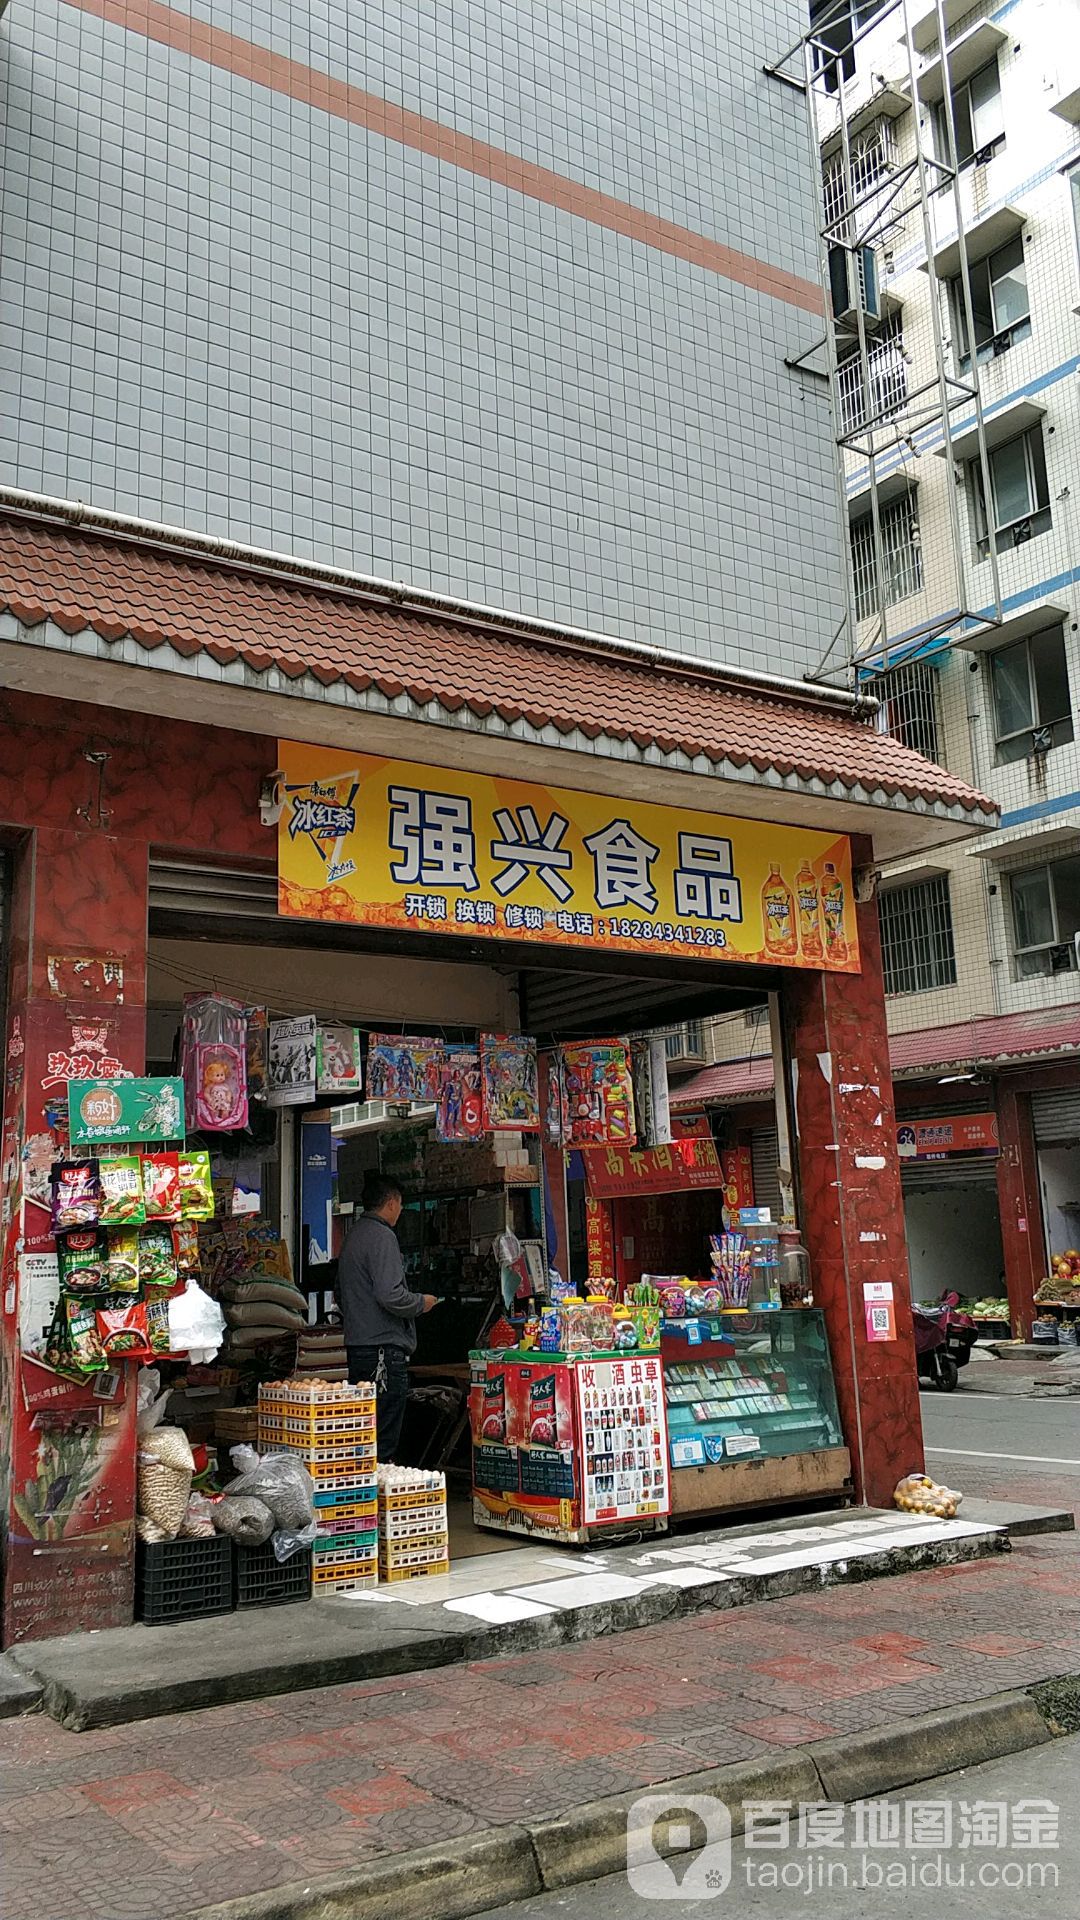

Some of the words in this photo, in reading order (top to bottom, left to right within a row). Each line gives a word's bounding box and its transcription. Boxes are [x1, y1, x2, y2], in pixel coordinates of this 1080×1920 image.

[288, 796, 356, 838] 冰红茶
[388, 785, 743, 923] 强兴食品
[405, 893, 447, 920] 开锁
[456, 898, 496, 925] 换锁
[504, 904, 545, 930] 修锁
[581, 1360, 659, 1389] 收酒虫草
